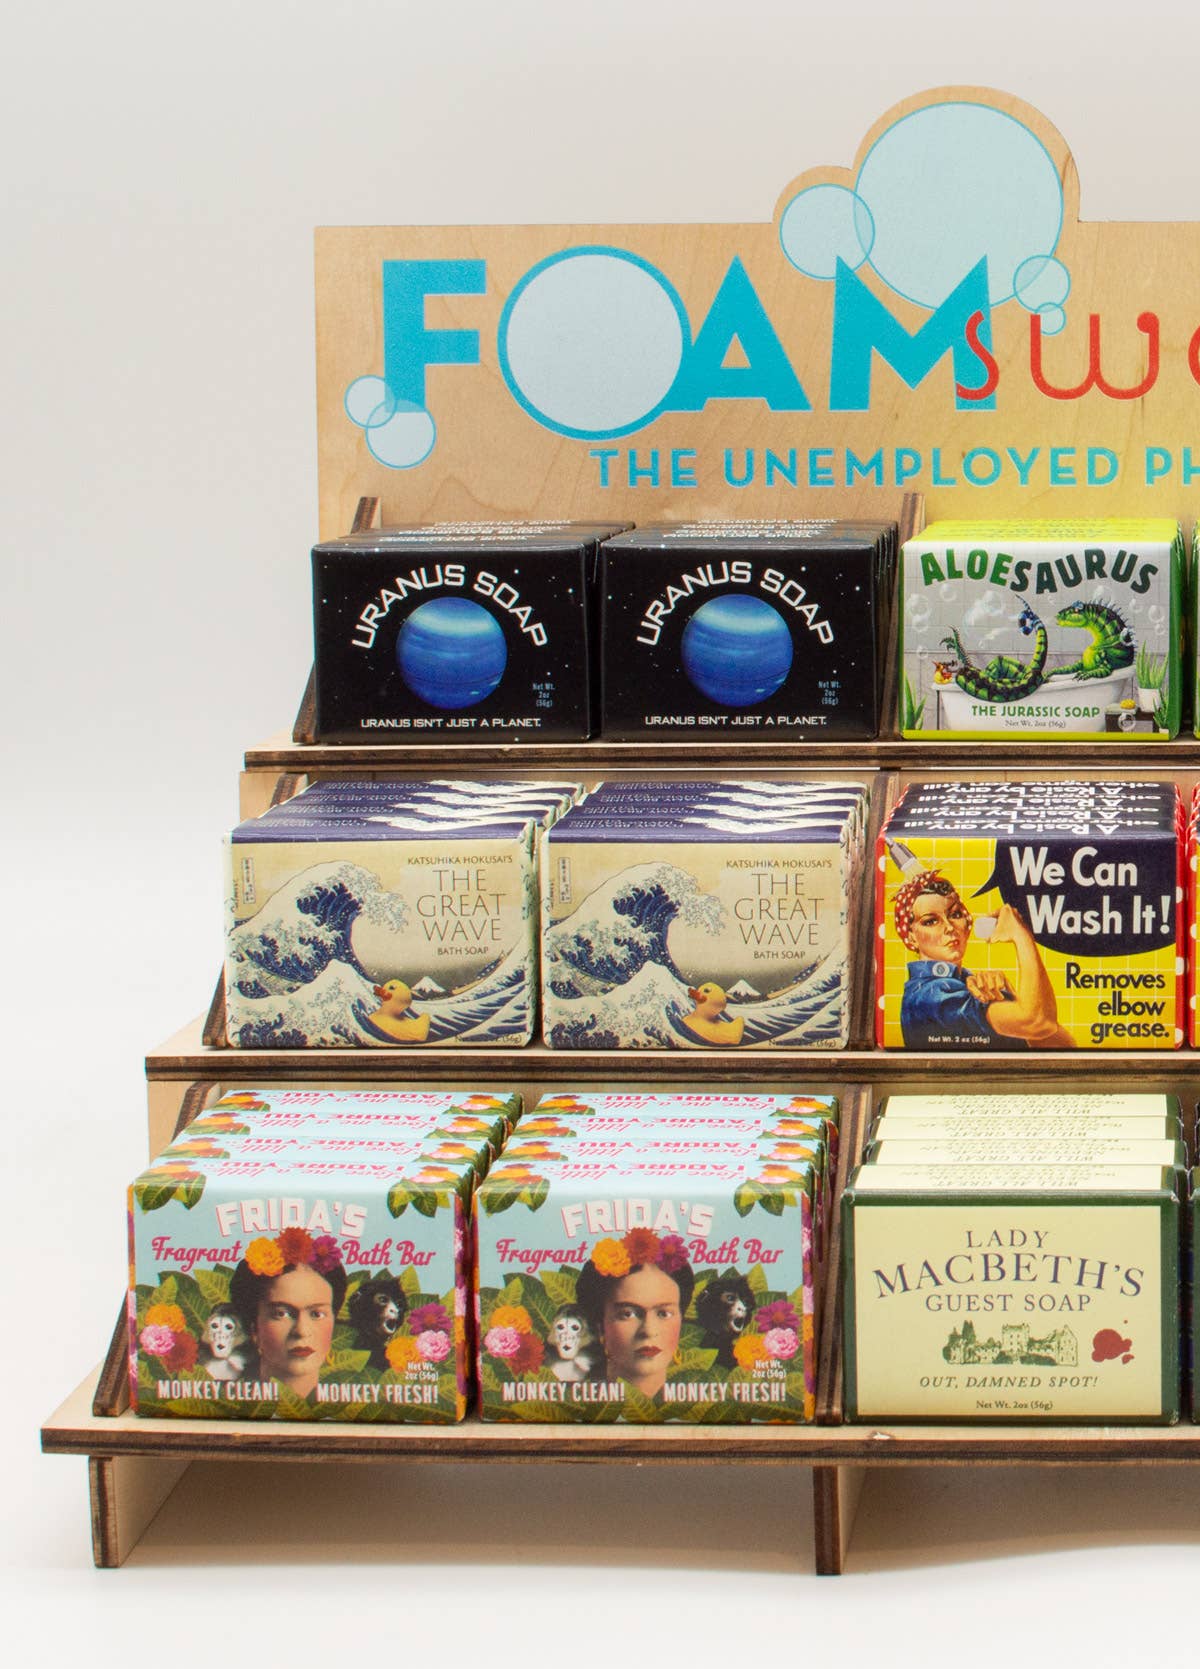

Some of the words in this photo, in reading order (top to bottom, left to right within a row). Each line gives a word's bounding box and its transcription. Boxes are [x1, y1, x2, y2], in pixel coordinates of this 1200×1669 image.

[382, 245, 997, 440] FOAM
[590, 448, 699, 488] THE
[724, 446, 1120, 488] UNEMPLOYED
[920, 549, 1158, 595] ALOESAURUS
[352, 564, 466, 648] URANUS
[473, 571, 548, 647] SOAP
[637, 561, 752, 646] URANUS
[760, 568, 834, 644] SOAP
[361, 719, 410, 727] URANUS
[413, 719, 444, 727] ISN'T
[447, 718, 476, 727] JUST
[481, 719, 489, 727] A
[492, 718, 541, 727] PLANET.
[645, 717, 695, 725] URANUS
[698, 717, 728, 725] ISN'T
[731, 716, 761, 725] JUST
[777, 716, 827, 725] PLANET.
[972, 706, 996, 716] THE
[1000, 706, 1061, 717] JURASSIC
[1065, 707, 1100, 718] SOAP
[726, 860, 779, 868] KATSUHIKA
[782, 859, 832, 868] HOKUSAI'S
[1009, 846, 1065, 886] We
[1072, 846, 1138, 886] Can
[432, 869, 486, 892] THE
[752, 873, 805, 895] THE
[417, 894, 506, 917] GREAT
[734, 898, 824, 921] GREAT
[1027, 895, 1122, 934] Wash
[1133, 895, 1172, 934] It!
[422, 919, 502, 941] WAVE
[739, 924, 819, 945] WAVE
[438, 947, 463, 955] BATH
[466, 946, 489, 955] SOAP
[754, 951, 779, 959] BATH
[781, 951, 806, 959] SOAP
[1066, 963, 1166, 989] Removes
[1098, 991, 1166, 1016] elbow
[1090, 1022, 1169, 1044] grease.
[215, 1198, 368, 1238] FRIDA'S
[561, 1199, 715, 1238] FRIDA'S
[966, 1229, 1049, 1248] LADY
[151, 1236, 242, 1272] Fragrant
[342, 1240, 392, 1266] Bath
[396, 1241, 437, 1266] Bar
[496, 1238, 588, 1273] Fragrant
[687, 1237, 738, 1265] Bath
[743, 1240, 784, 1264] Bar
[873, 1252, 1144, 1299] MACBETH'S
[925, 1295, 1013, 1312] GUEST
[1024, 1295, 1091, 1312] SOAP
[158, 1380, 222, 1400] MONKEY
[227, 1382, 279, 1400] CLEAN!
[317, 1383, 380, 1404] MONKEY
[385, 1383, 439, 1404] FRESH!
[503, 1382, 567, 1401] MONKEY
[573, 1382, 625, 1401] CLEAN!
[664, 1382, 727, 1401] MONKEY
[733, 1382, 787, 1402] FRESH!
[920, 1377, 960, 1388] OUT,
[966, 1377, 1041, 1387] DAMNED
[1049, 1377, 1099, 1388] SPOT!
[976, 1401, 992, 1409] Net
[995, 1401, 1011, 1409] Wt.
[1013, 1401, 1027, 1409] 2oz
[1030, 1400, 1053, 1411] (56g)
